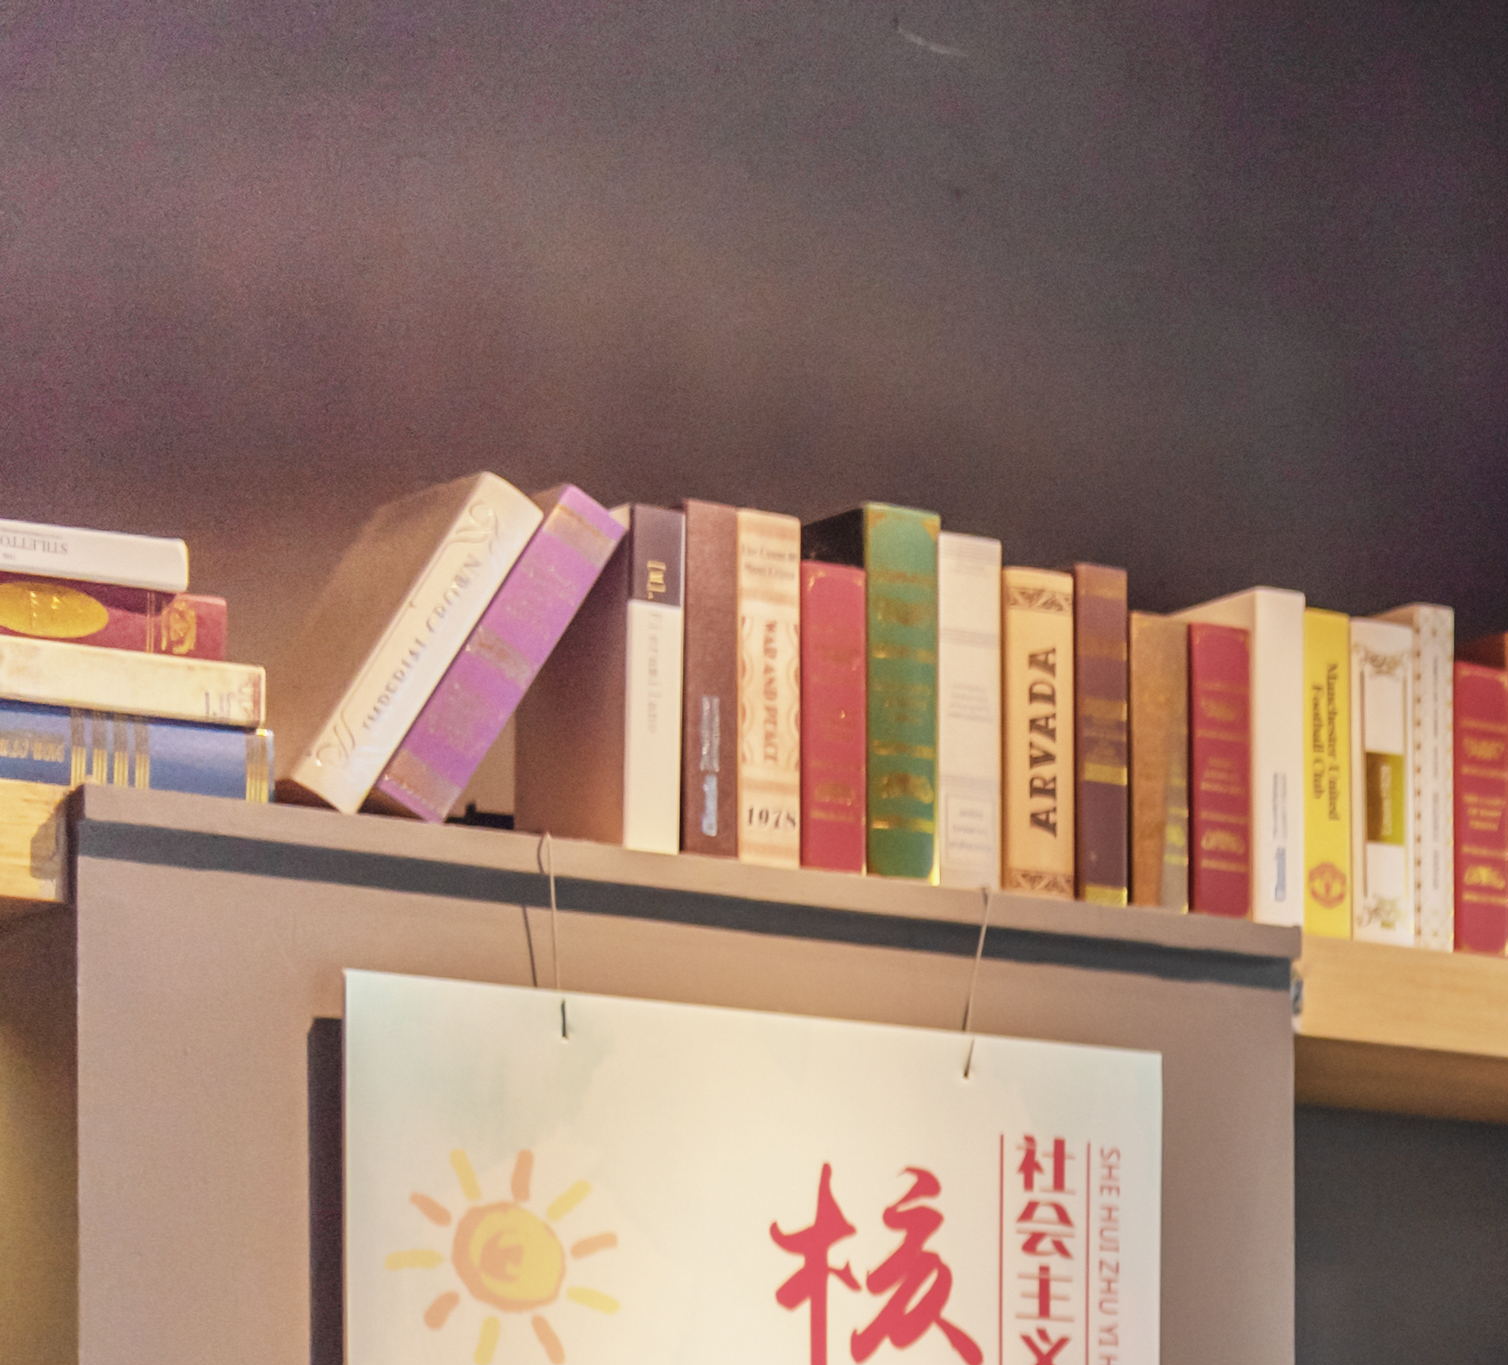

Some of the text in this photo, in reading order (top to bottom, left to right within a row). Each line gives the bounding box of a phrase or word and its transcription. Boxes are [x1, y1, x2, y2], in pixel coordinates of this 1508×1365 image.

[1027, 646, 1059, 839] ARVADA
[746, 805, 798, 831] 1978
[1098, 1147, 1122, 1197] SHE
[1098, 1205, 1122, 1251] HUI
[1098, 1259, 1122, 1316] ZHU
